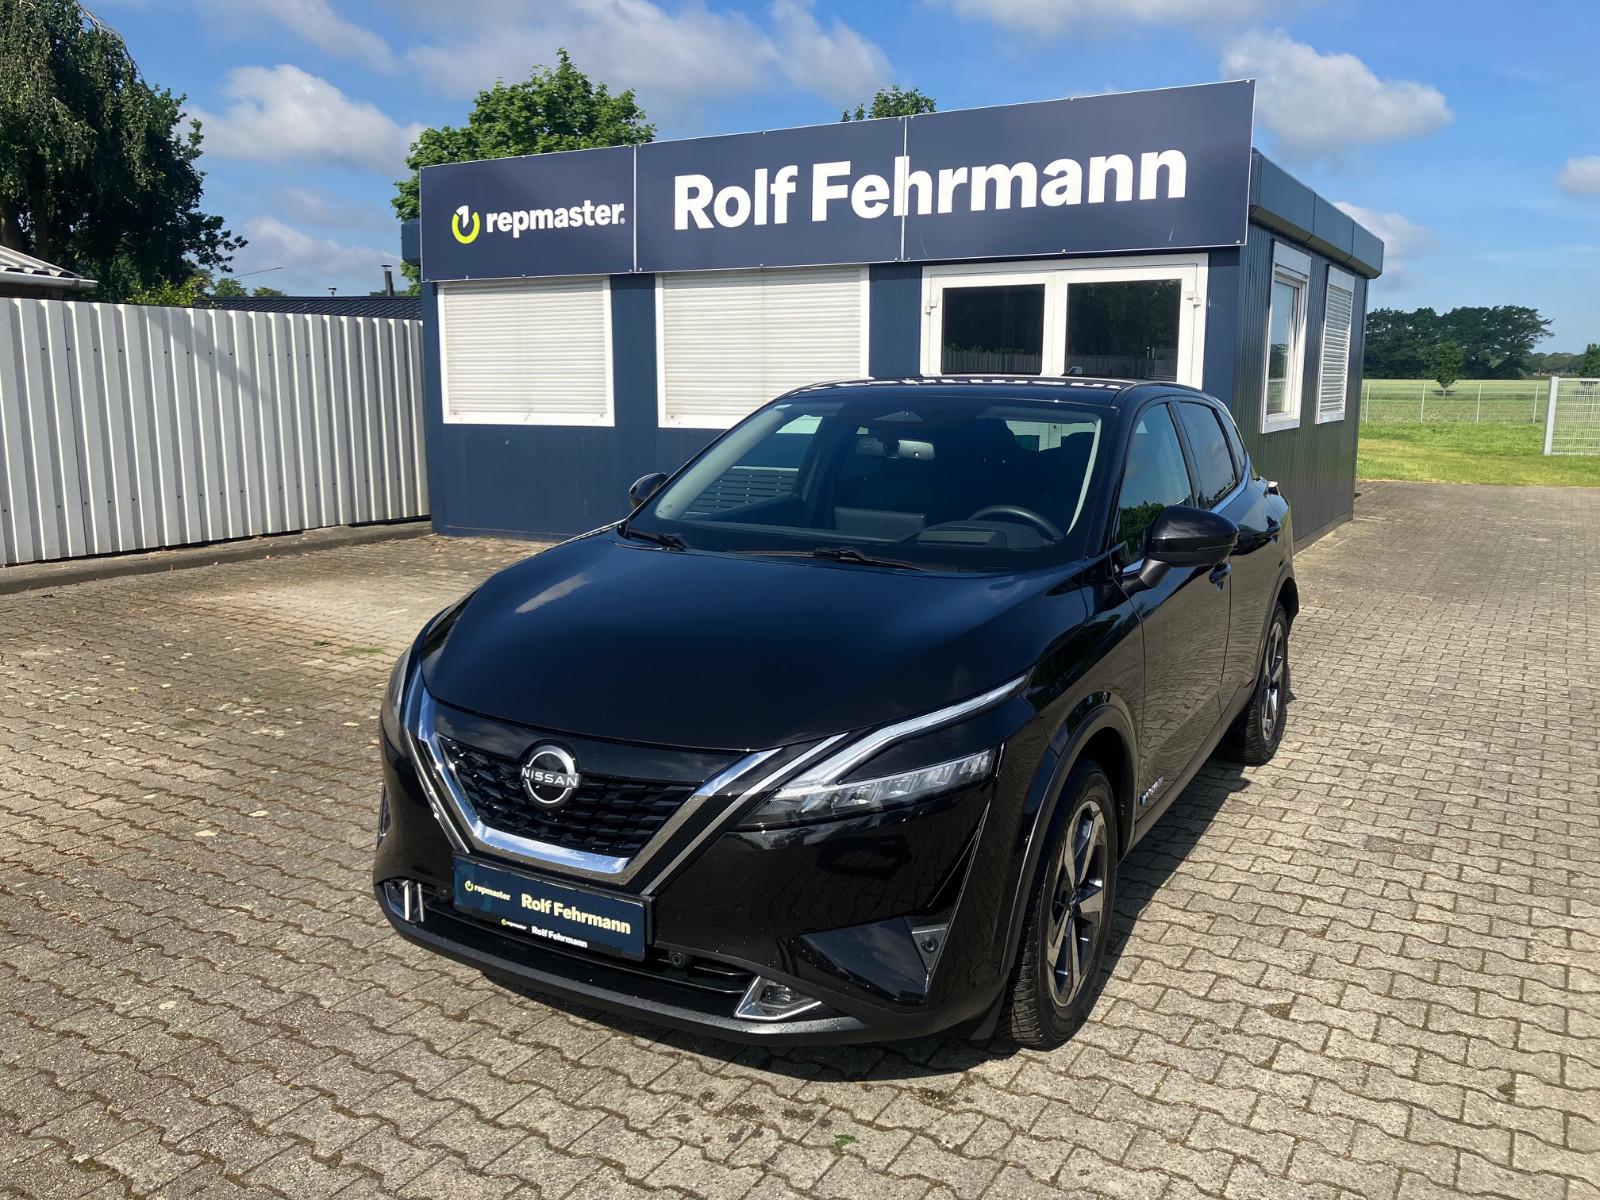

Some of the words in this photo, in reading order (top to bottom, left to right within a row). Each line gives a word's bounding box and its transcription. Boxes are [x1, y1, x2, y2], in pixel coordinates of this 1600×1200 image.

[674, 165, 798, 231] Rolf
[812, 148, 1187, 221] Fehrmann
[521, 767, 579, 787] NISSAN
[521, 893, 552, 914] Rolf
[554, 902, 631, 935] Fehrmann
[531, 926, 548, 937] Rolf
[548, 931, 588, 948] Fehrmann
